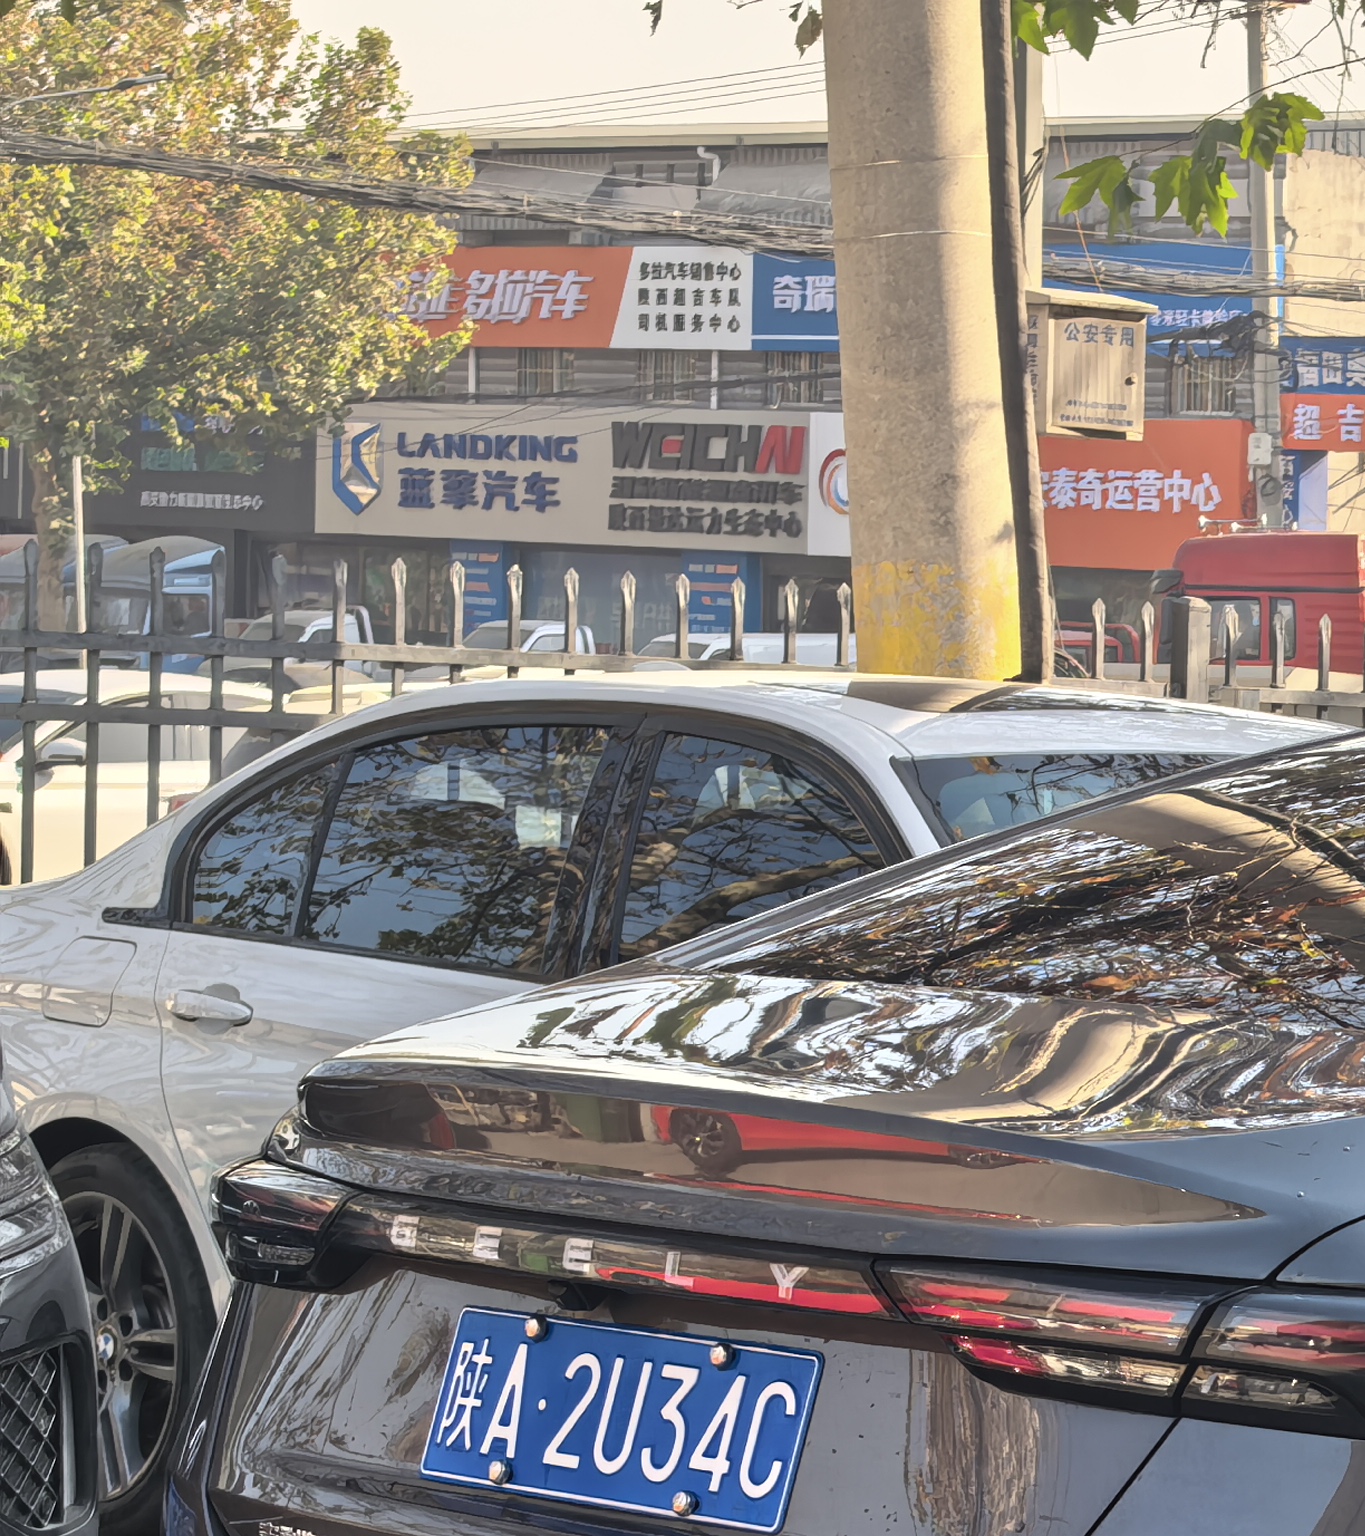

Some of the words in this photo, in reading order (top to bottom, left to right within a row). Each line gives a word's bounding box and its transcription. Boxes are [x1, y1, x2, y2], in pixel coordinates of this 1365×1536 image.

[1064, 321, 1135, 347] 公安专用
[397, 432, 578, 462] LANDKING
[1042, 467, 1222, 513] 泰奇运营中心
[389, 1214, 809, 1300] GEELY
